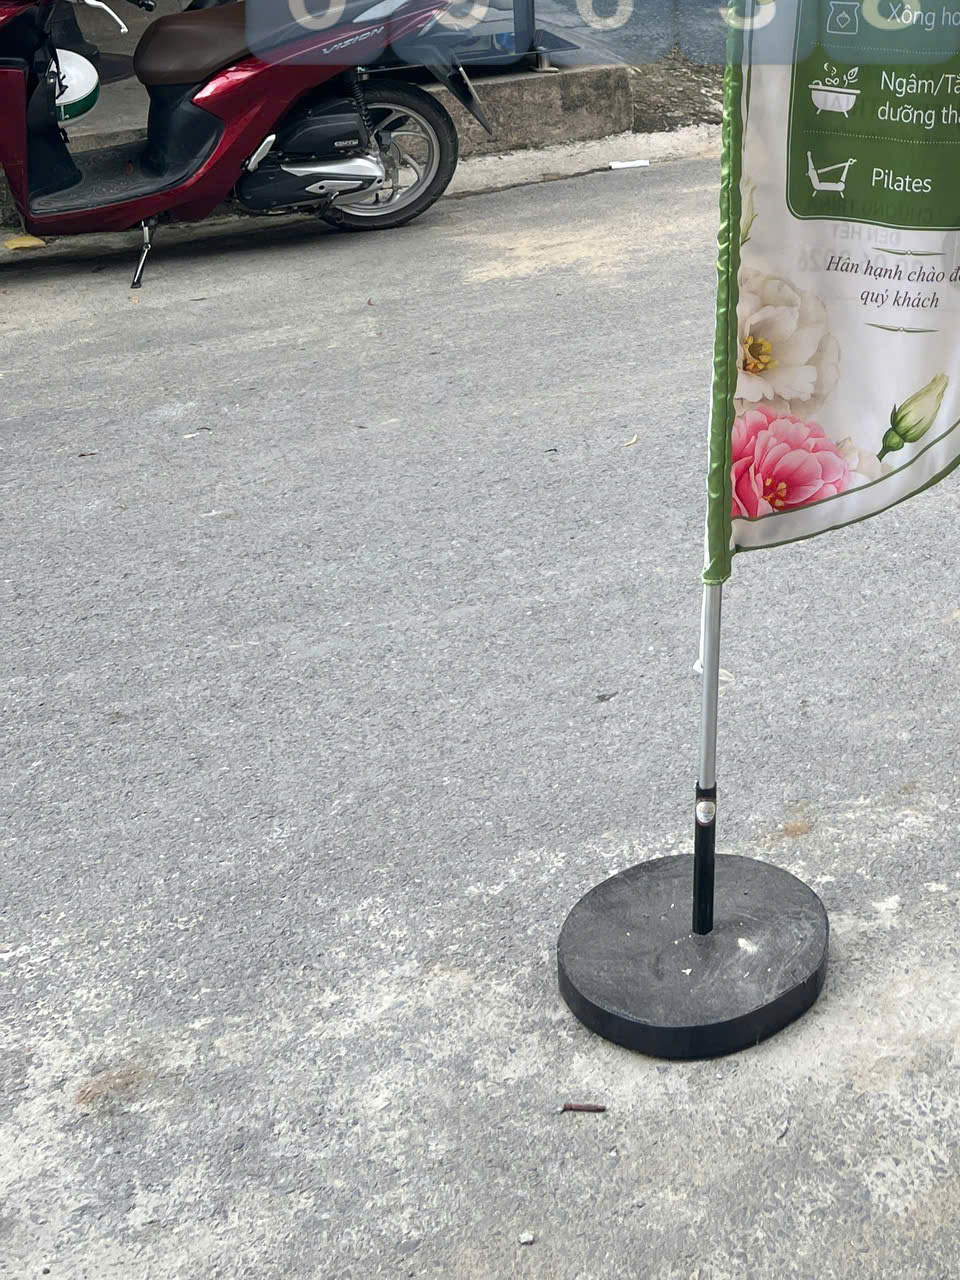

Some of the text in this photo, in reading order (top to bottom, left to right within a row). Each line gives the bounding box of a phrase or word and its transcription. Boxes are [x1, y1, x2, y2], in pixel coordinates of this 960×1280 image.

[887, 2, 936, 31] Xông
[322, 26, 384, 54] VISION
[878, 101, 935, 129] dưỡng
[872, 168, 932, 194] Pilates
[826, 255, 860, 274] Hân
[863, 261, 903, 282] hạnh
[907, 264, 945, 283] chào
[860, 288, 940, 309] quý khách
